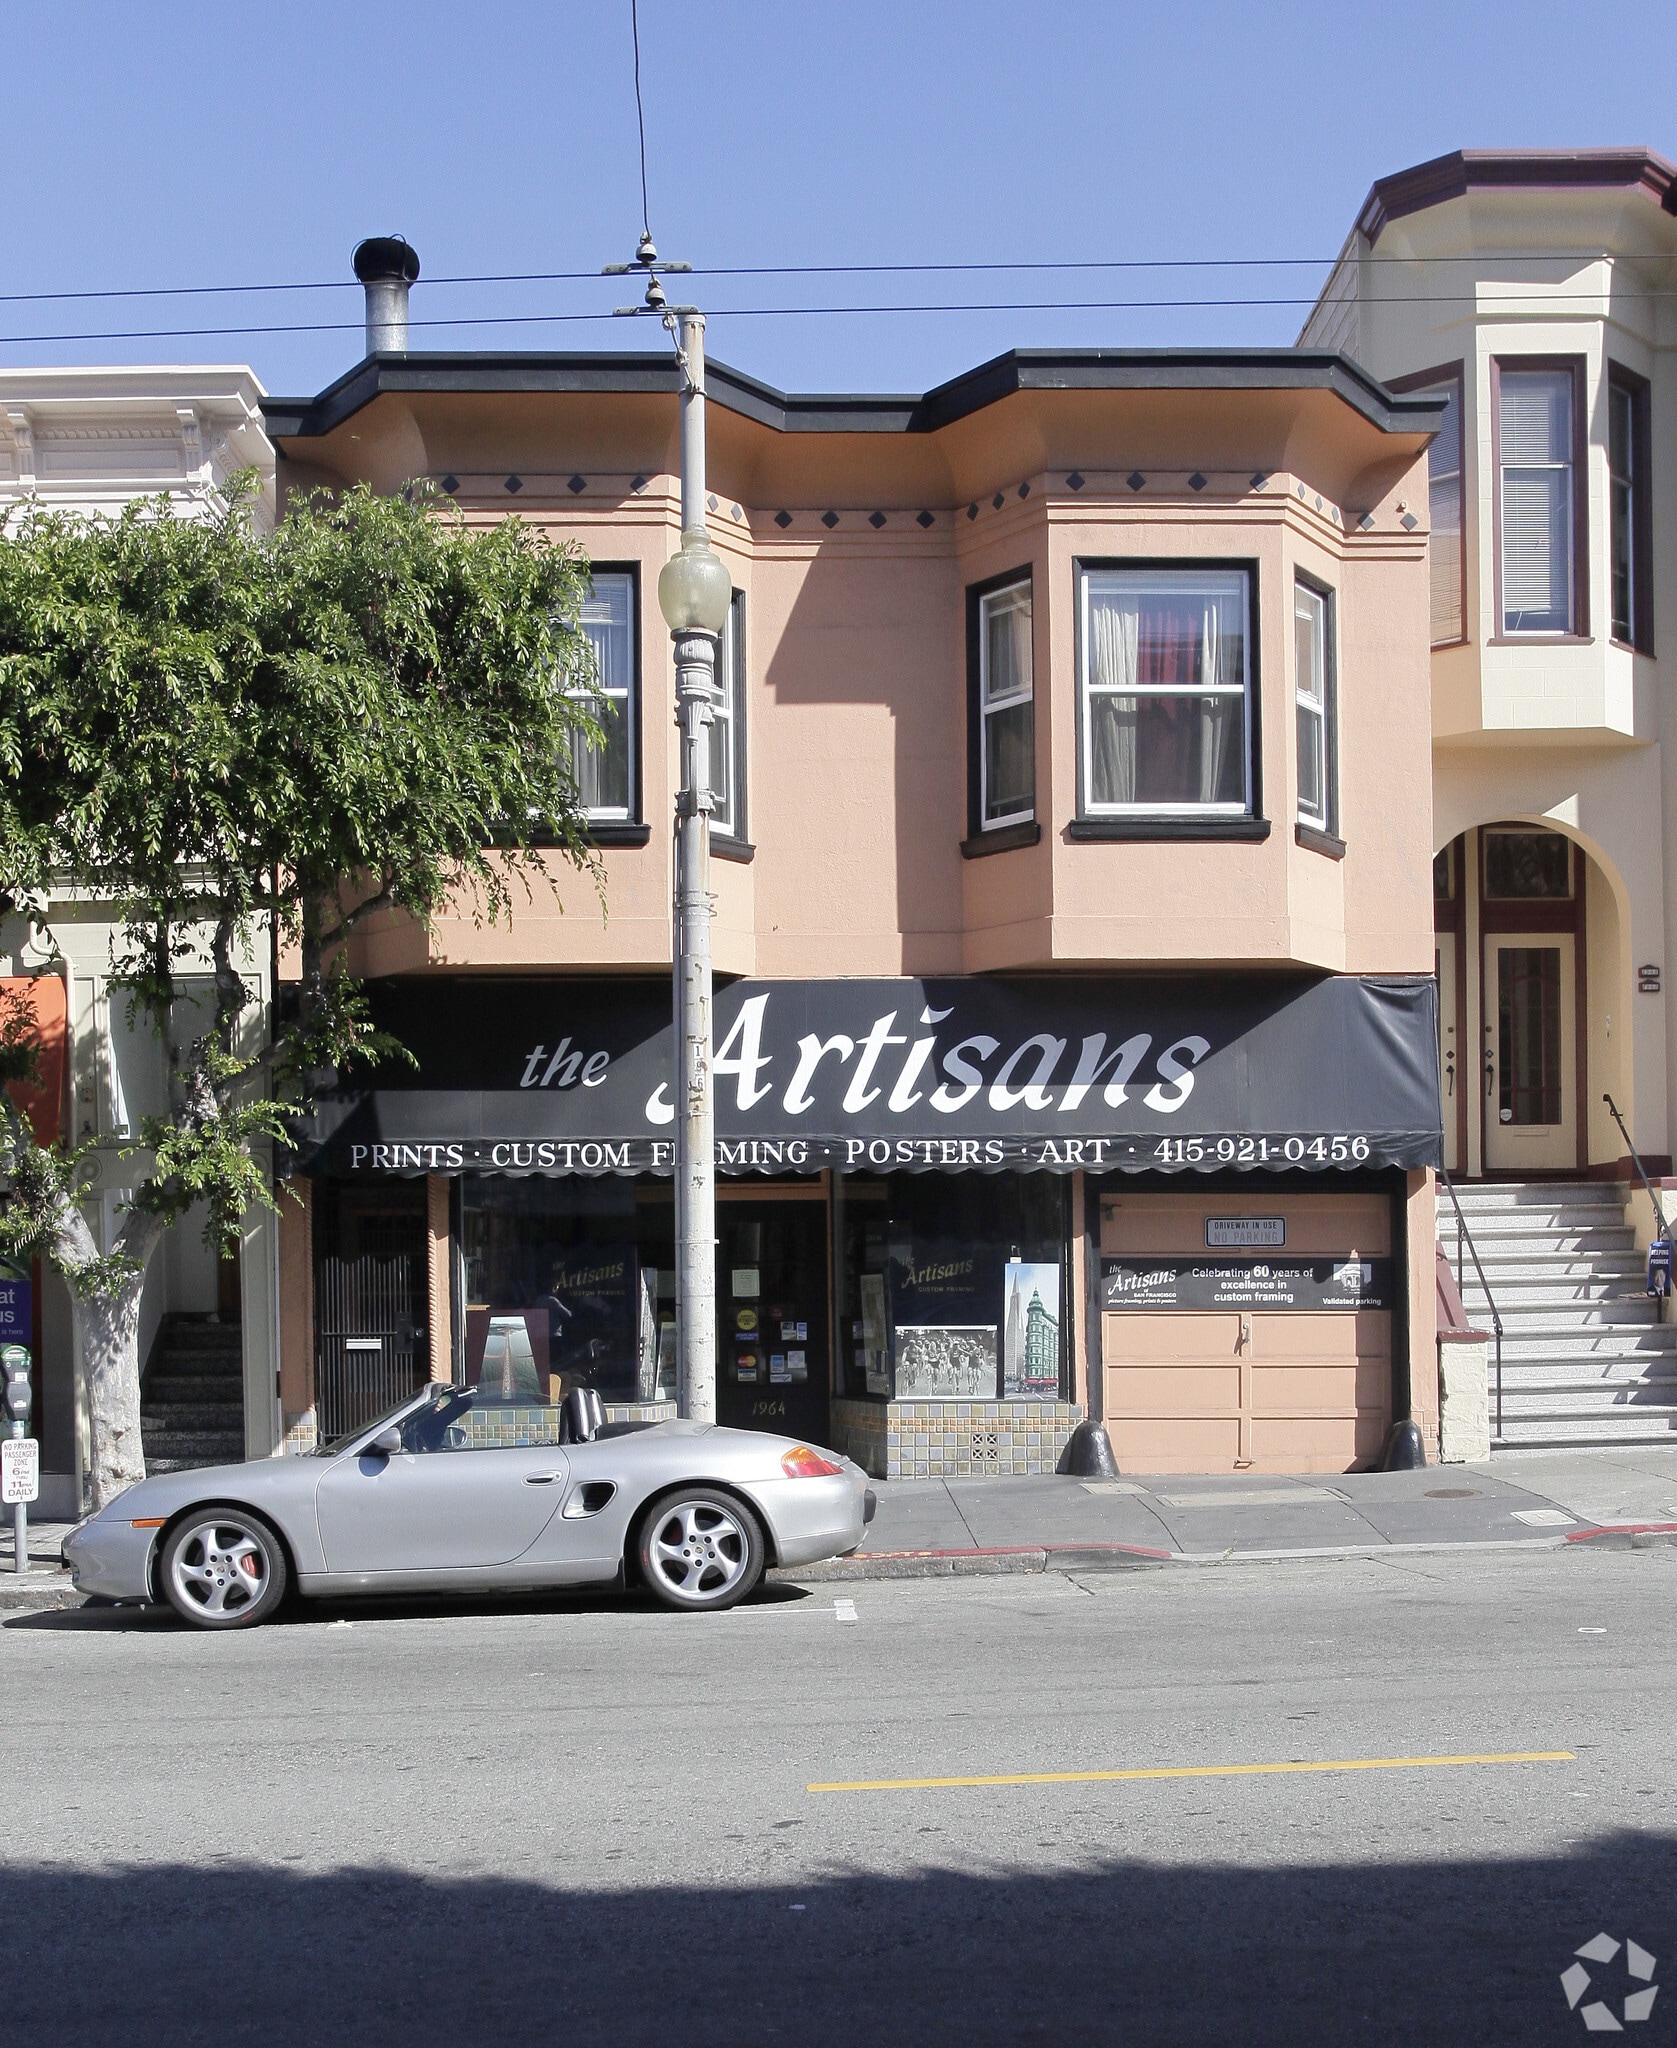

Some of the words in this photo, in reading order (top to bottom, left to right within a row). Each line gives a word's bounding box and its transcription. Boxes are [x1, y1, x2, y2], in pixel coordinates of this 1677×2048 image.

[519, 1037, 610, 1088] the
[644, 991, 1211, 1125] Artisans
[351, 1144, 464, 1169] PRINTS
[491, 1142, 631, 1168] CUSTOM
[651, 1140, 809, 1166] FMING
[845, 1138, 1004, 1164] POSTERS
[1037, 1139, 1111, 1163] ART
[1153, 1135, 1370, 1162] 415-921-0456
[1214, 1221, 1249, 1230] DRIVEWAY
[1252, 1221, 1260, 1229] IN
[1263, 1221, 1277, 1229] USE
[1214, 1232, 1228, 1243] NO
[1233, 1231, 1278, 1243] PARKING
[901, 1259, 974, 1289] Artisans
[1109, 1265, 1121, 1274] the
[1192, 1267, 1251, 1279] Celebrating
[1253, 1265, 1270, 1278] 60
[1272, 1271, 1300, 1280] years
[1302, 1267, 1314, 1277] of
[552, 1262, 624, 1293] Artisans
[1108, 1269, 1176, 1295] Artisans
[1220, 1280, 1275, 1290] excellence
[1277, 1280, 1287, 1289] in
[1213, 1293, 1252, 1302] custom
[1254, 1292, 1294, 1303] framing
[1322, 1297, 1355, 1305] Validated
[1355, 1298, 1382, 1306] parking
[752, 1402, 785, 1416] 1964
[13, 1442, 37, 1450] PARKING
[4, 1450, 37, 1459] PASSENGER
[13, 1459, 28, 1467] ZONE
[8, 1488, 34, 1497] DAILY
